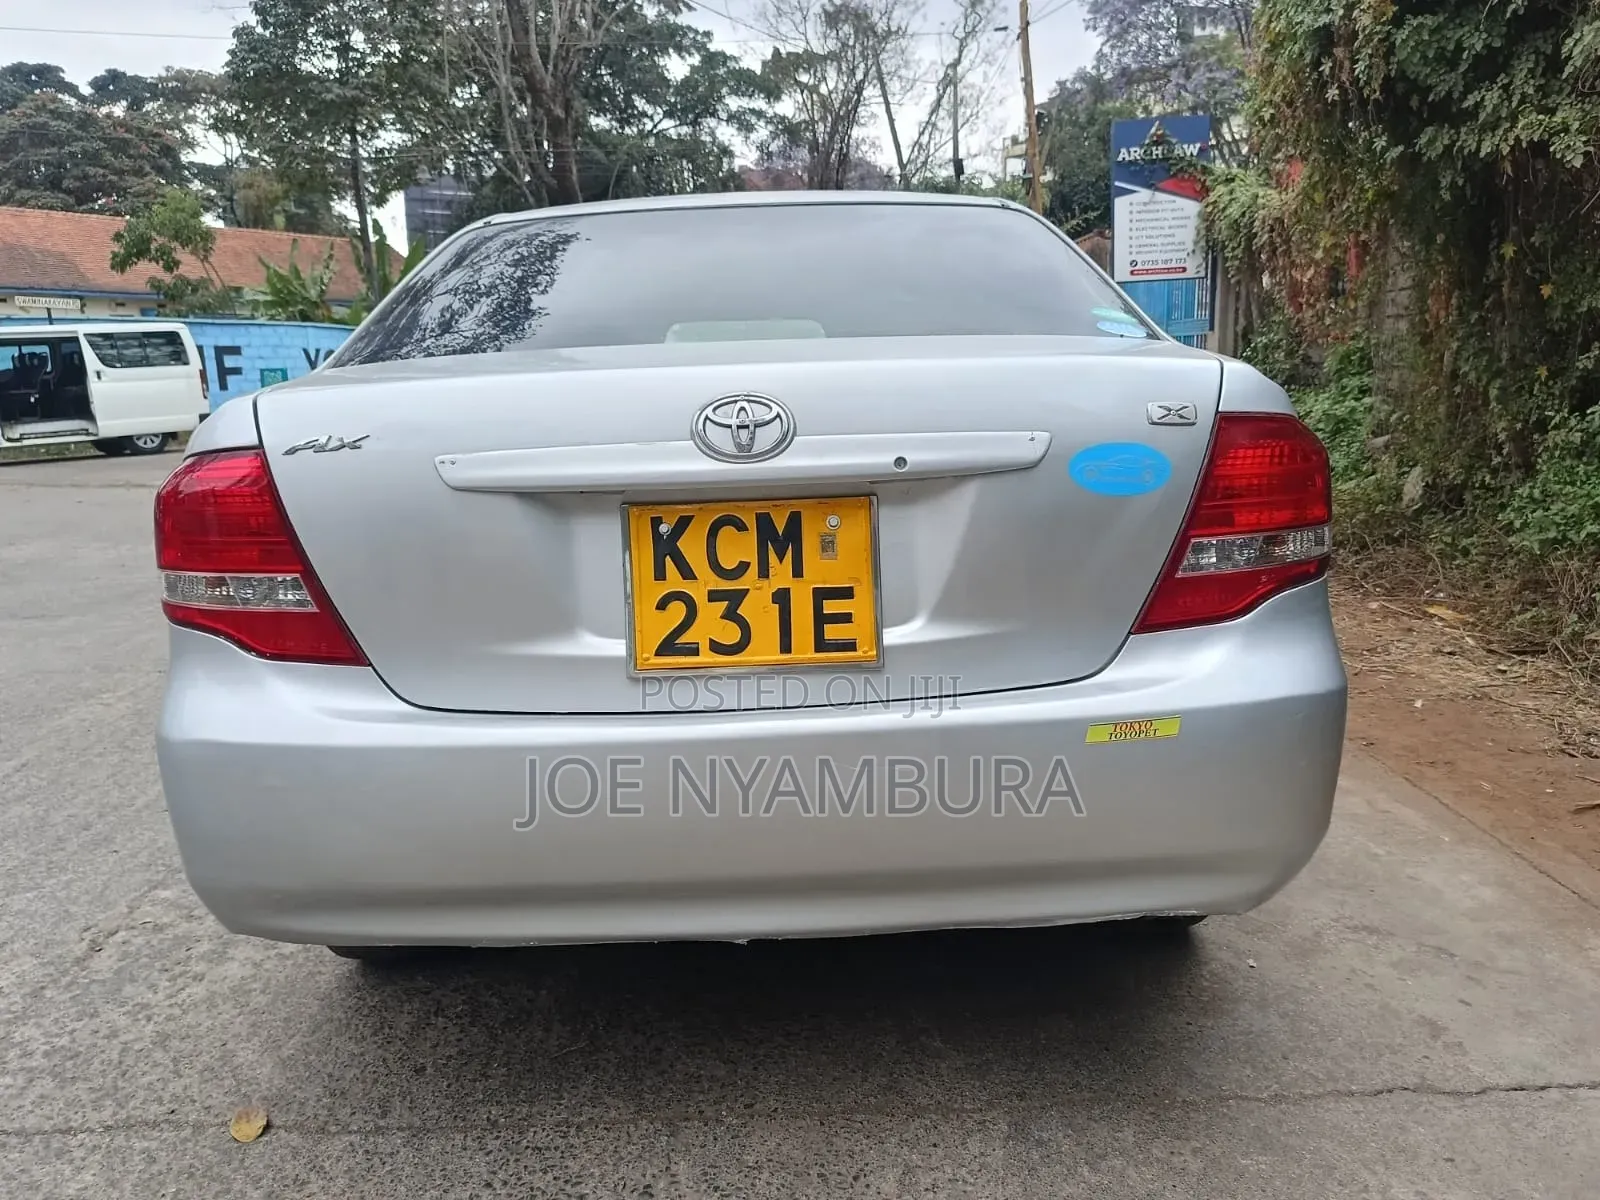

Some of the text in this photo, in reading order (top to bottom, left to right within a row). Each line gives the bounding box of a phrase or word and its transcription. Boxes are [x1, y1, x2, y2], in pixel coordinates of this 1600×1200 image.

[650, 510, 804, 582] KCM
[653, 586, 858, 657] 231E
[1108, 728, 1159, 740] TOYOPET
[1112, 720, 1153, 733] TOKYO
